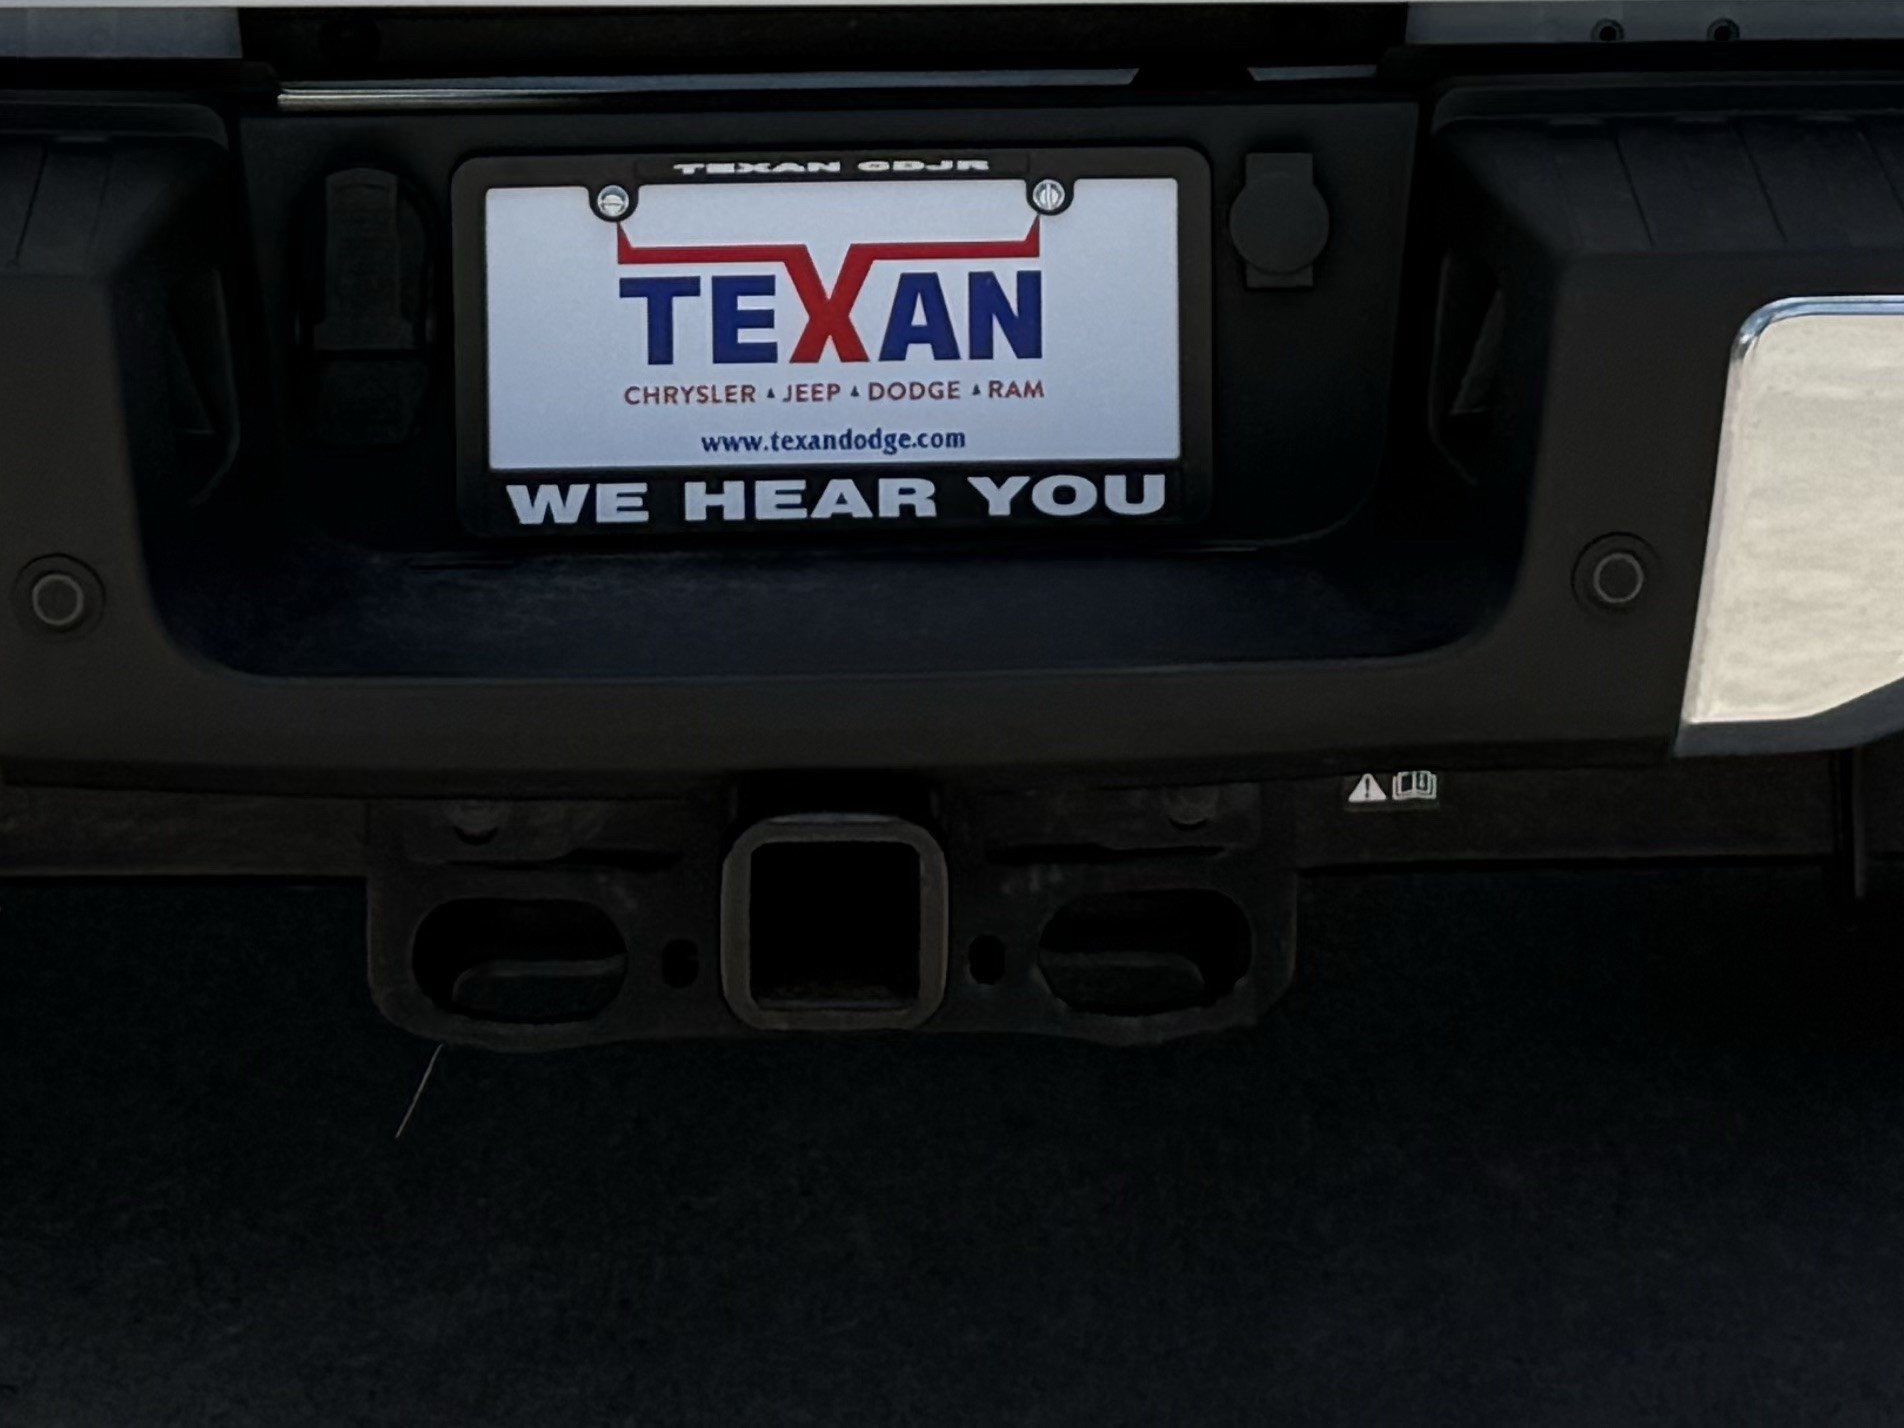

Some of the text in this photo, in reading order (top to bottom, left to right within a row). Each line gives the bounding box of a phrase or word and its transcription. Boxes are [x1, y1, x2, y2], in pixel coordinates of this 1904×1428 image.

[673, 162, 841, 175] TEXAN
[617, 243, 1043, 365] TEXAN
[624, 380, 1045, 405] CHRYSLER JEEP DODGE RAM
[701, 427, 966, 456] www.texandodge.com
[505, 474, 1166, 525] WE HEAR YOU
